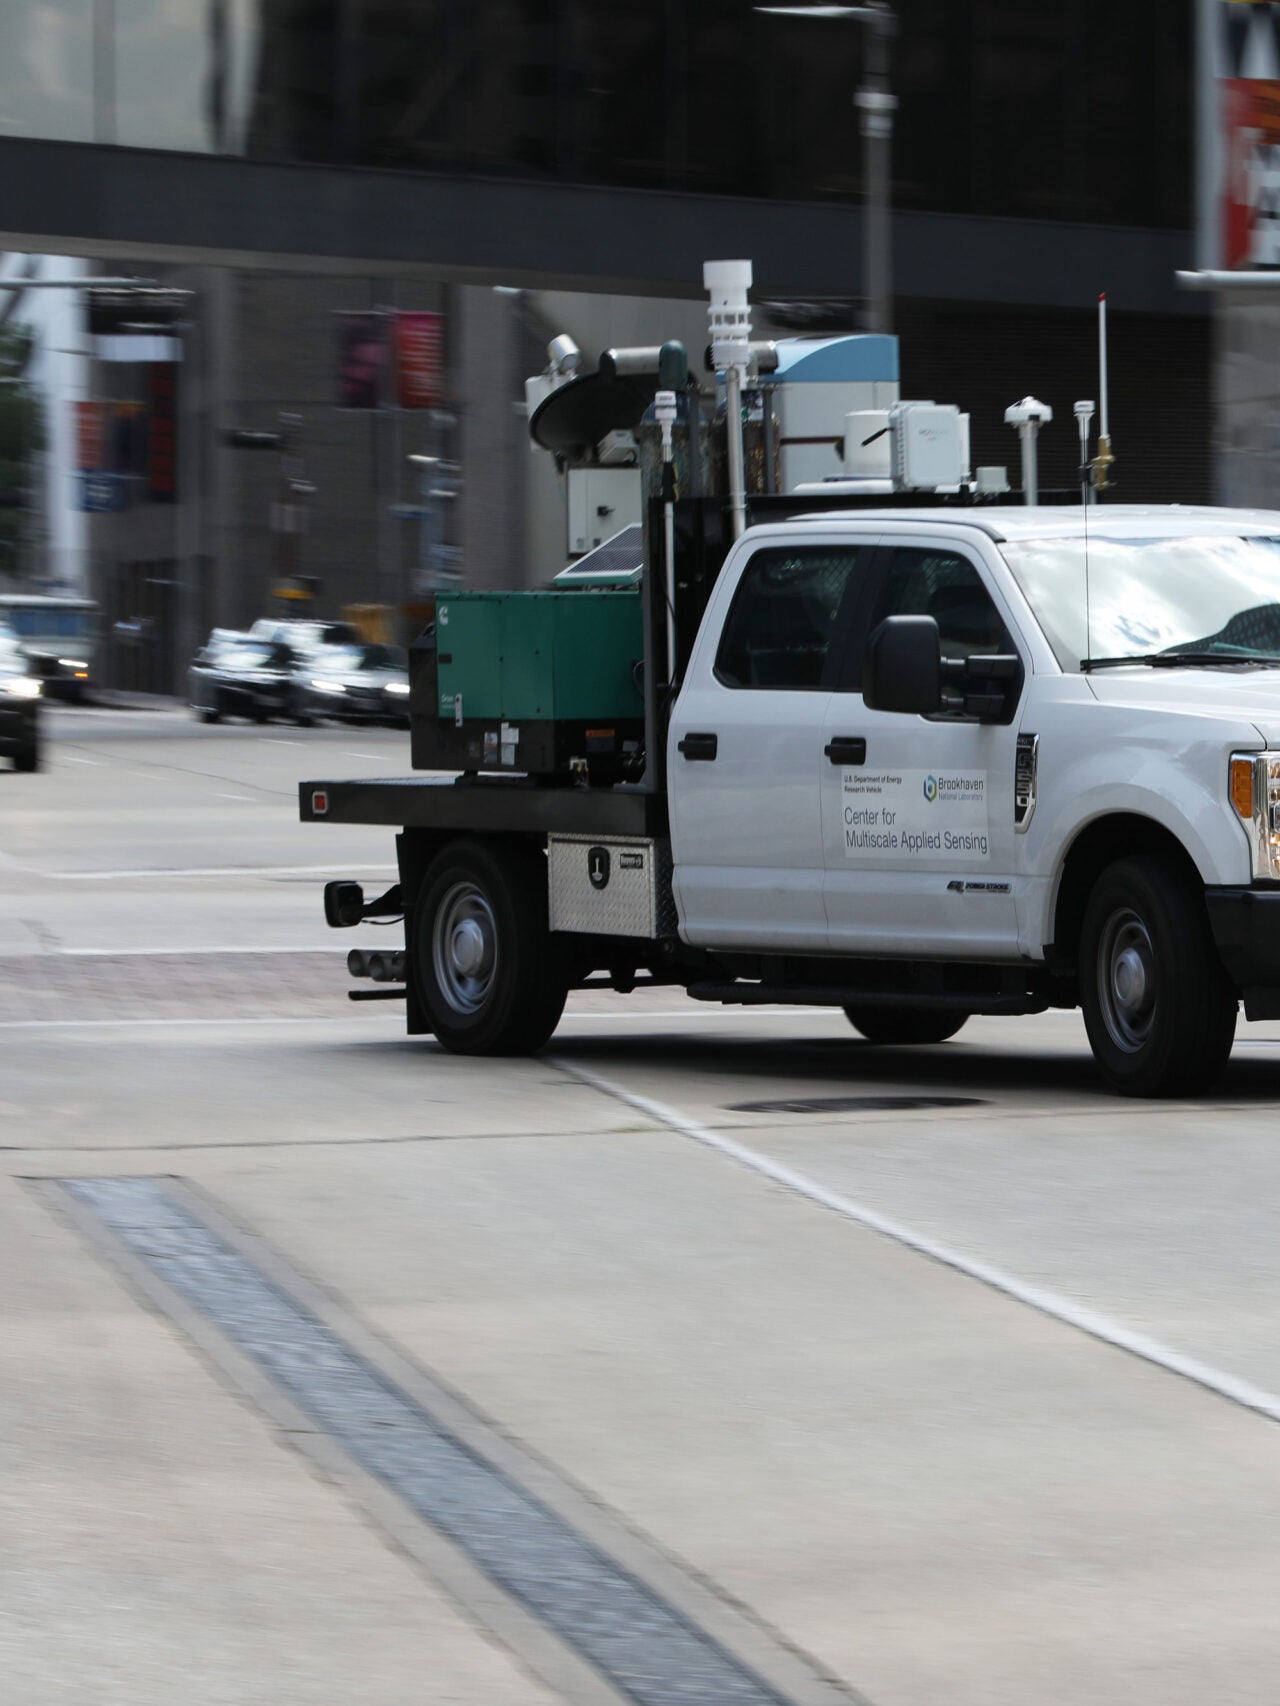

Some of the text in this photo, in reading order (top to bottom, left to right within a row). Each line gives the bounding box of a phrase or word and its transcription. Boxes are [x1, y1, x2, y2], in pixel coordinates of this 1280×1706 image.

[854, 776, 880, 784] Department
[886, 776, 902, 785] Energy
[938, 777, 984, 790] Brookhaven
[938, 792, 983, 801] National Laboratory
[844, 807, 896, 825] Center for
[846, 830, 988, 855] Multiscale Applied Sensing
